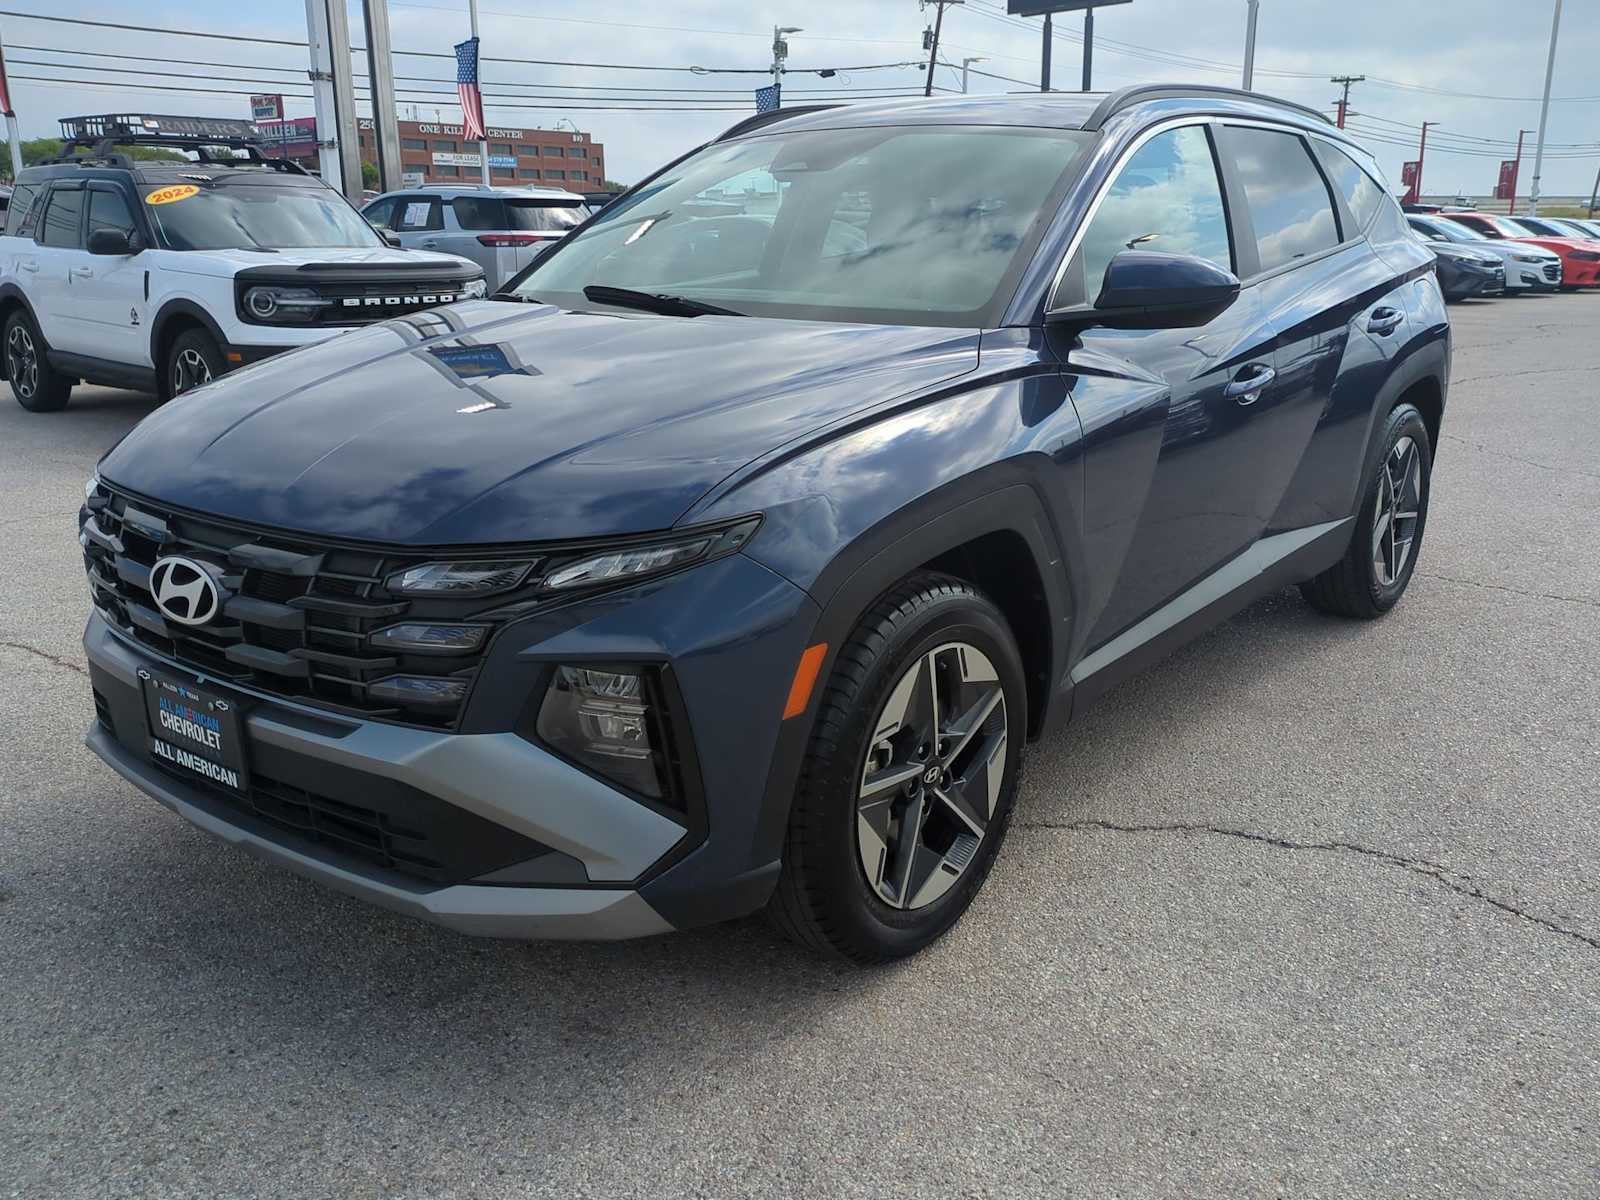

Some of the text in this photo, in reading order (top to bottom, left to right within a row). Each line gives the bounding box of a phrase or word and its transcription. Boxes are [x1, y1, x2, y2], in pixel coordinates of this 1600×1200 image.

[419, 124, 441, 134] ONE
[488, 129, 523, 139] CENTER
[152, 186, 195, 203] 2024
[343, 295, 453, 307] BRONCO
[160, 696, 219, 731] ALL AMERICAN
[160, 709, 221, 751] CHEVROLET
[154, 739, 238, 788] ALL AMERICAN
